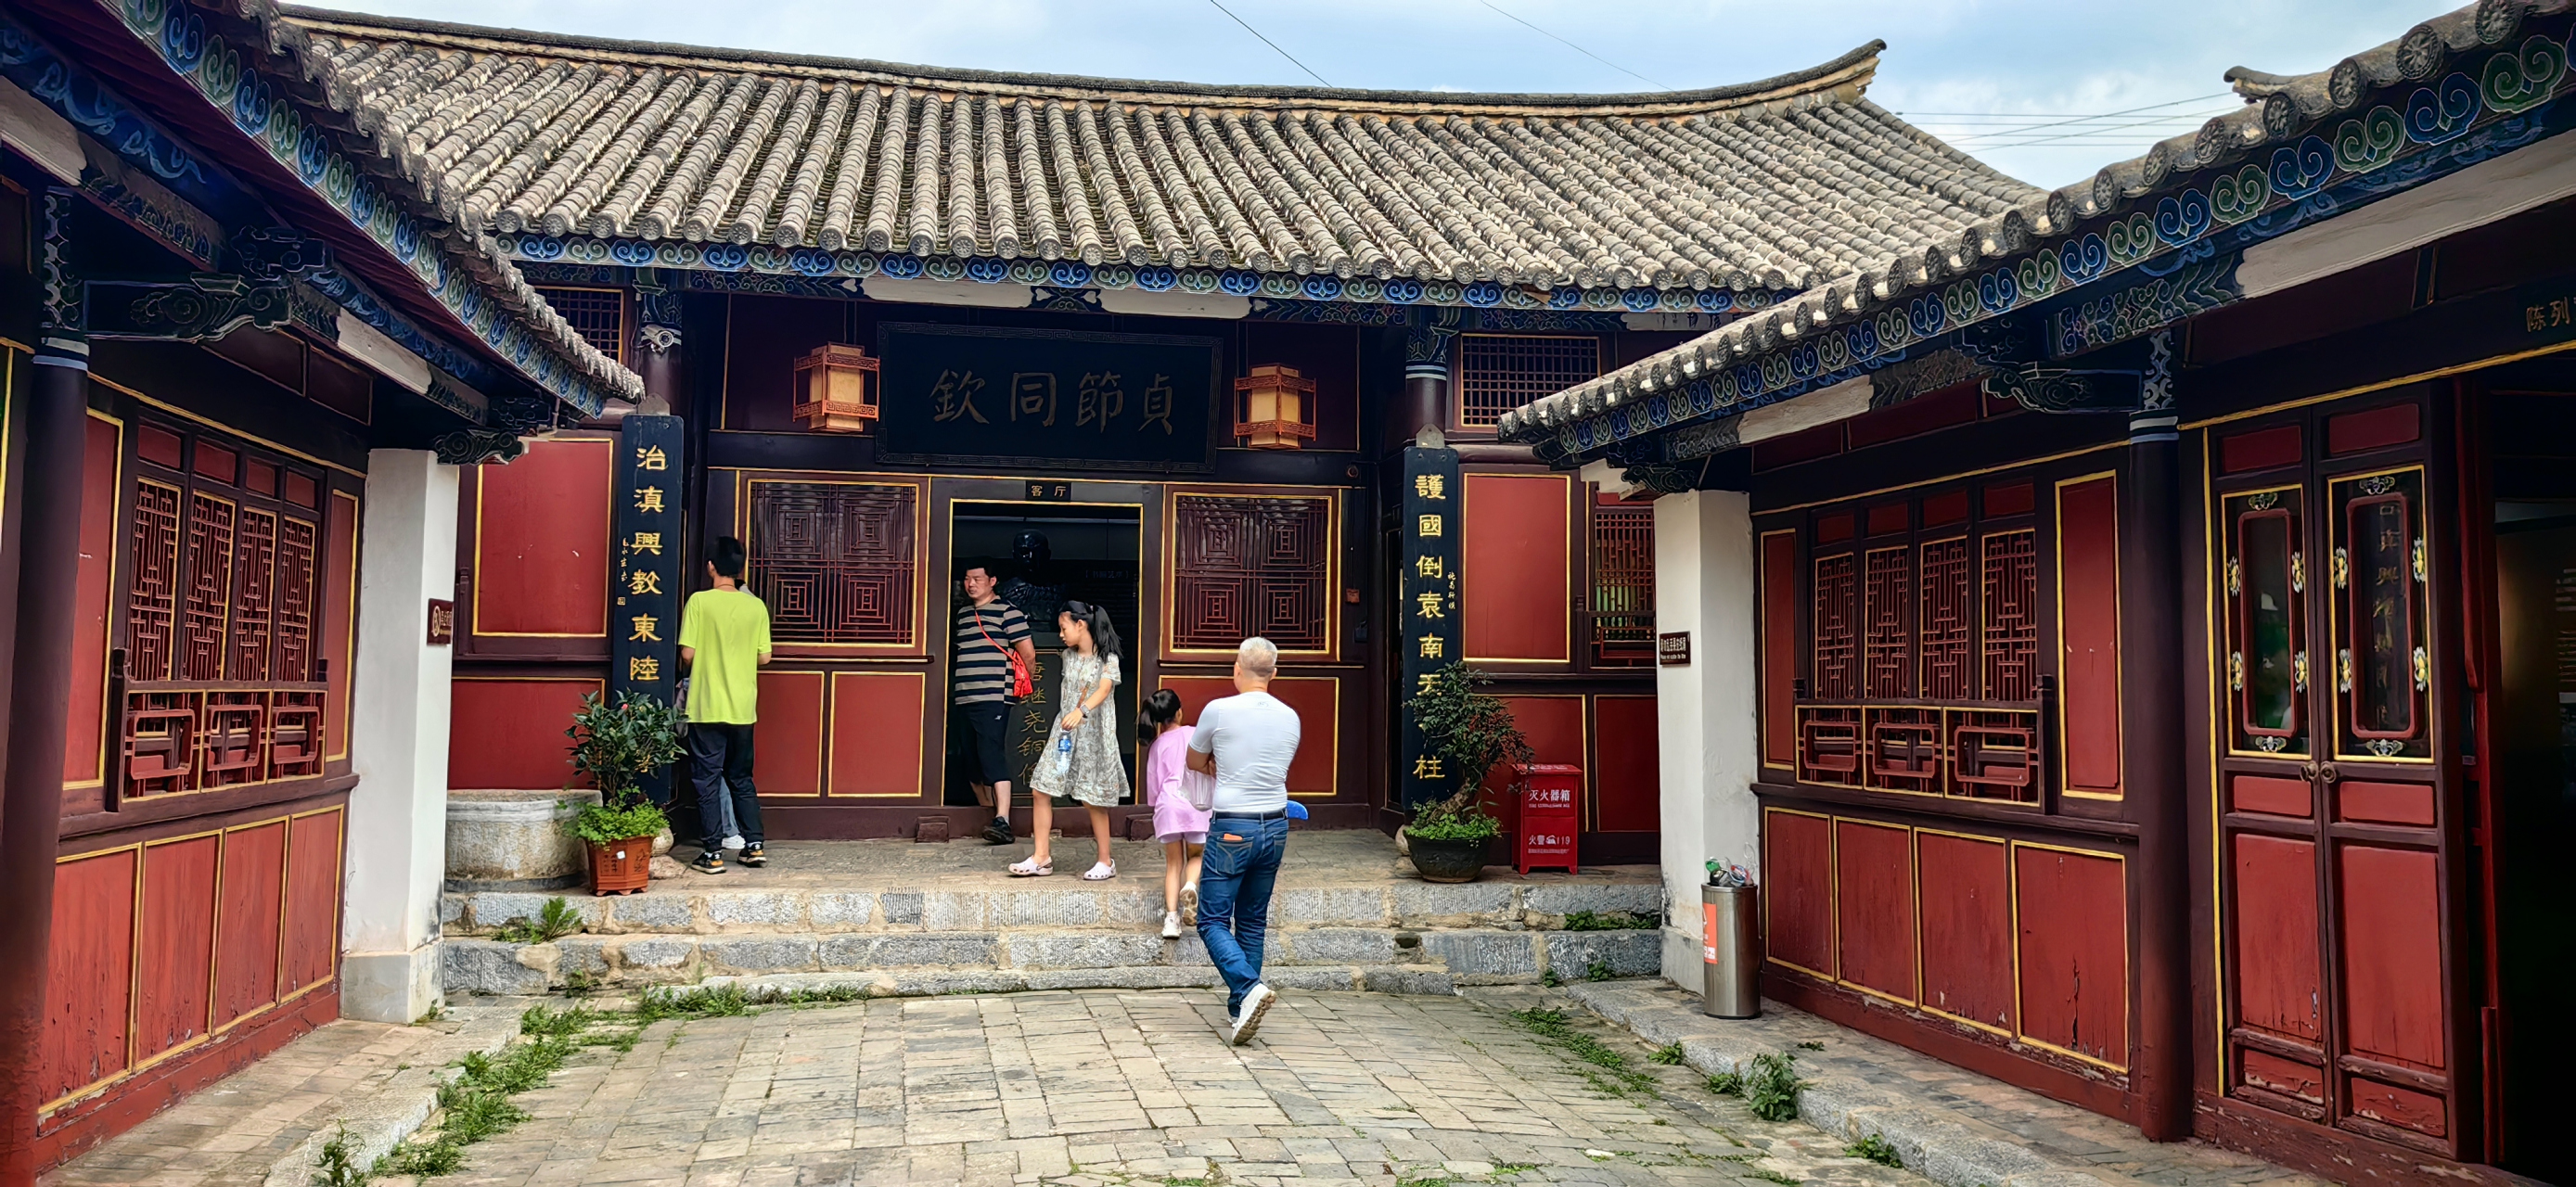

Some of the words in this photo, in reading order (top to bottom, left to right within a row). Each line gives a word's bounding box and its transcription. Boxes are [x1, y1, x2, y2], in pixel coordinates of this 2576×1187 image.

[2526, 296, 2576, 333] 陈列
[1031, 484, 1067, 498] 客厅
[628, 445, 667, 773] 治滇興教東陸
[1413, 474, 1446, 780] 護國倒袁南天柱
[1528, 788, 1570, 802] 灭火器箱
